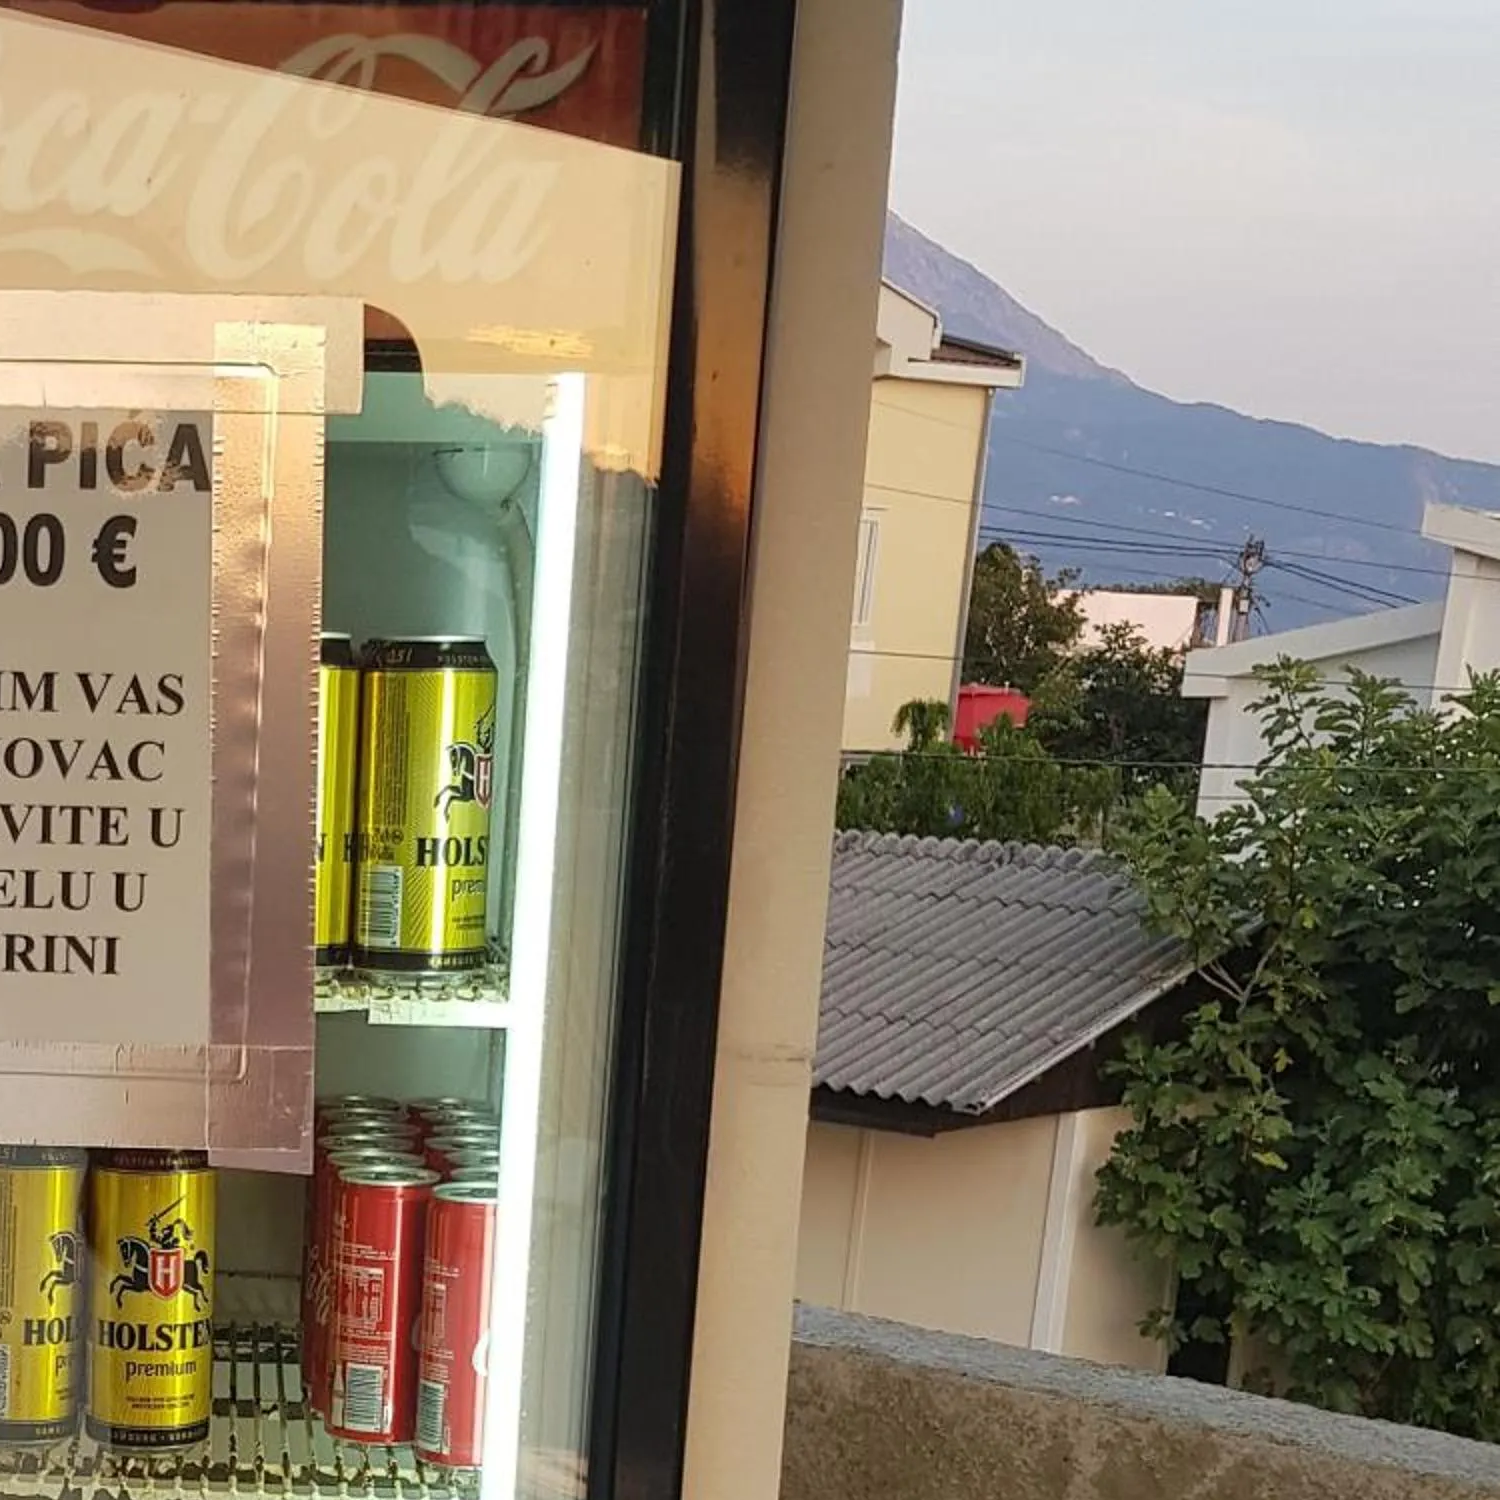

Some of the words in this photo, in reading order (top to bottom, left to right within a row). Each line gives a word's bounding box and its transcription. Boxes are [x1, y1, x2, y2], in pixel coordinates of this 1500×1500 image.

[28, 409, 212, 492] PIĆA
[91, 515, 138, 588] €
[77, 672, 185, 716] VAS
[149, 808, 184, 847] U
[416, 836, 489, 867] HOLS
[112, 872, 147, 912] U
